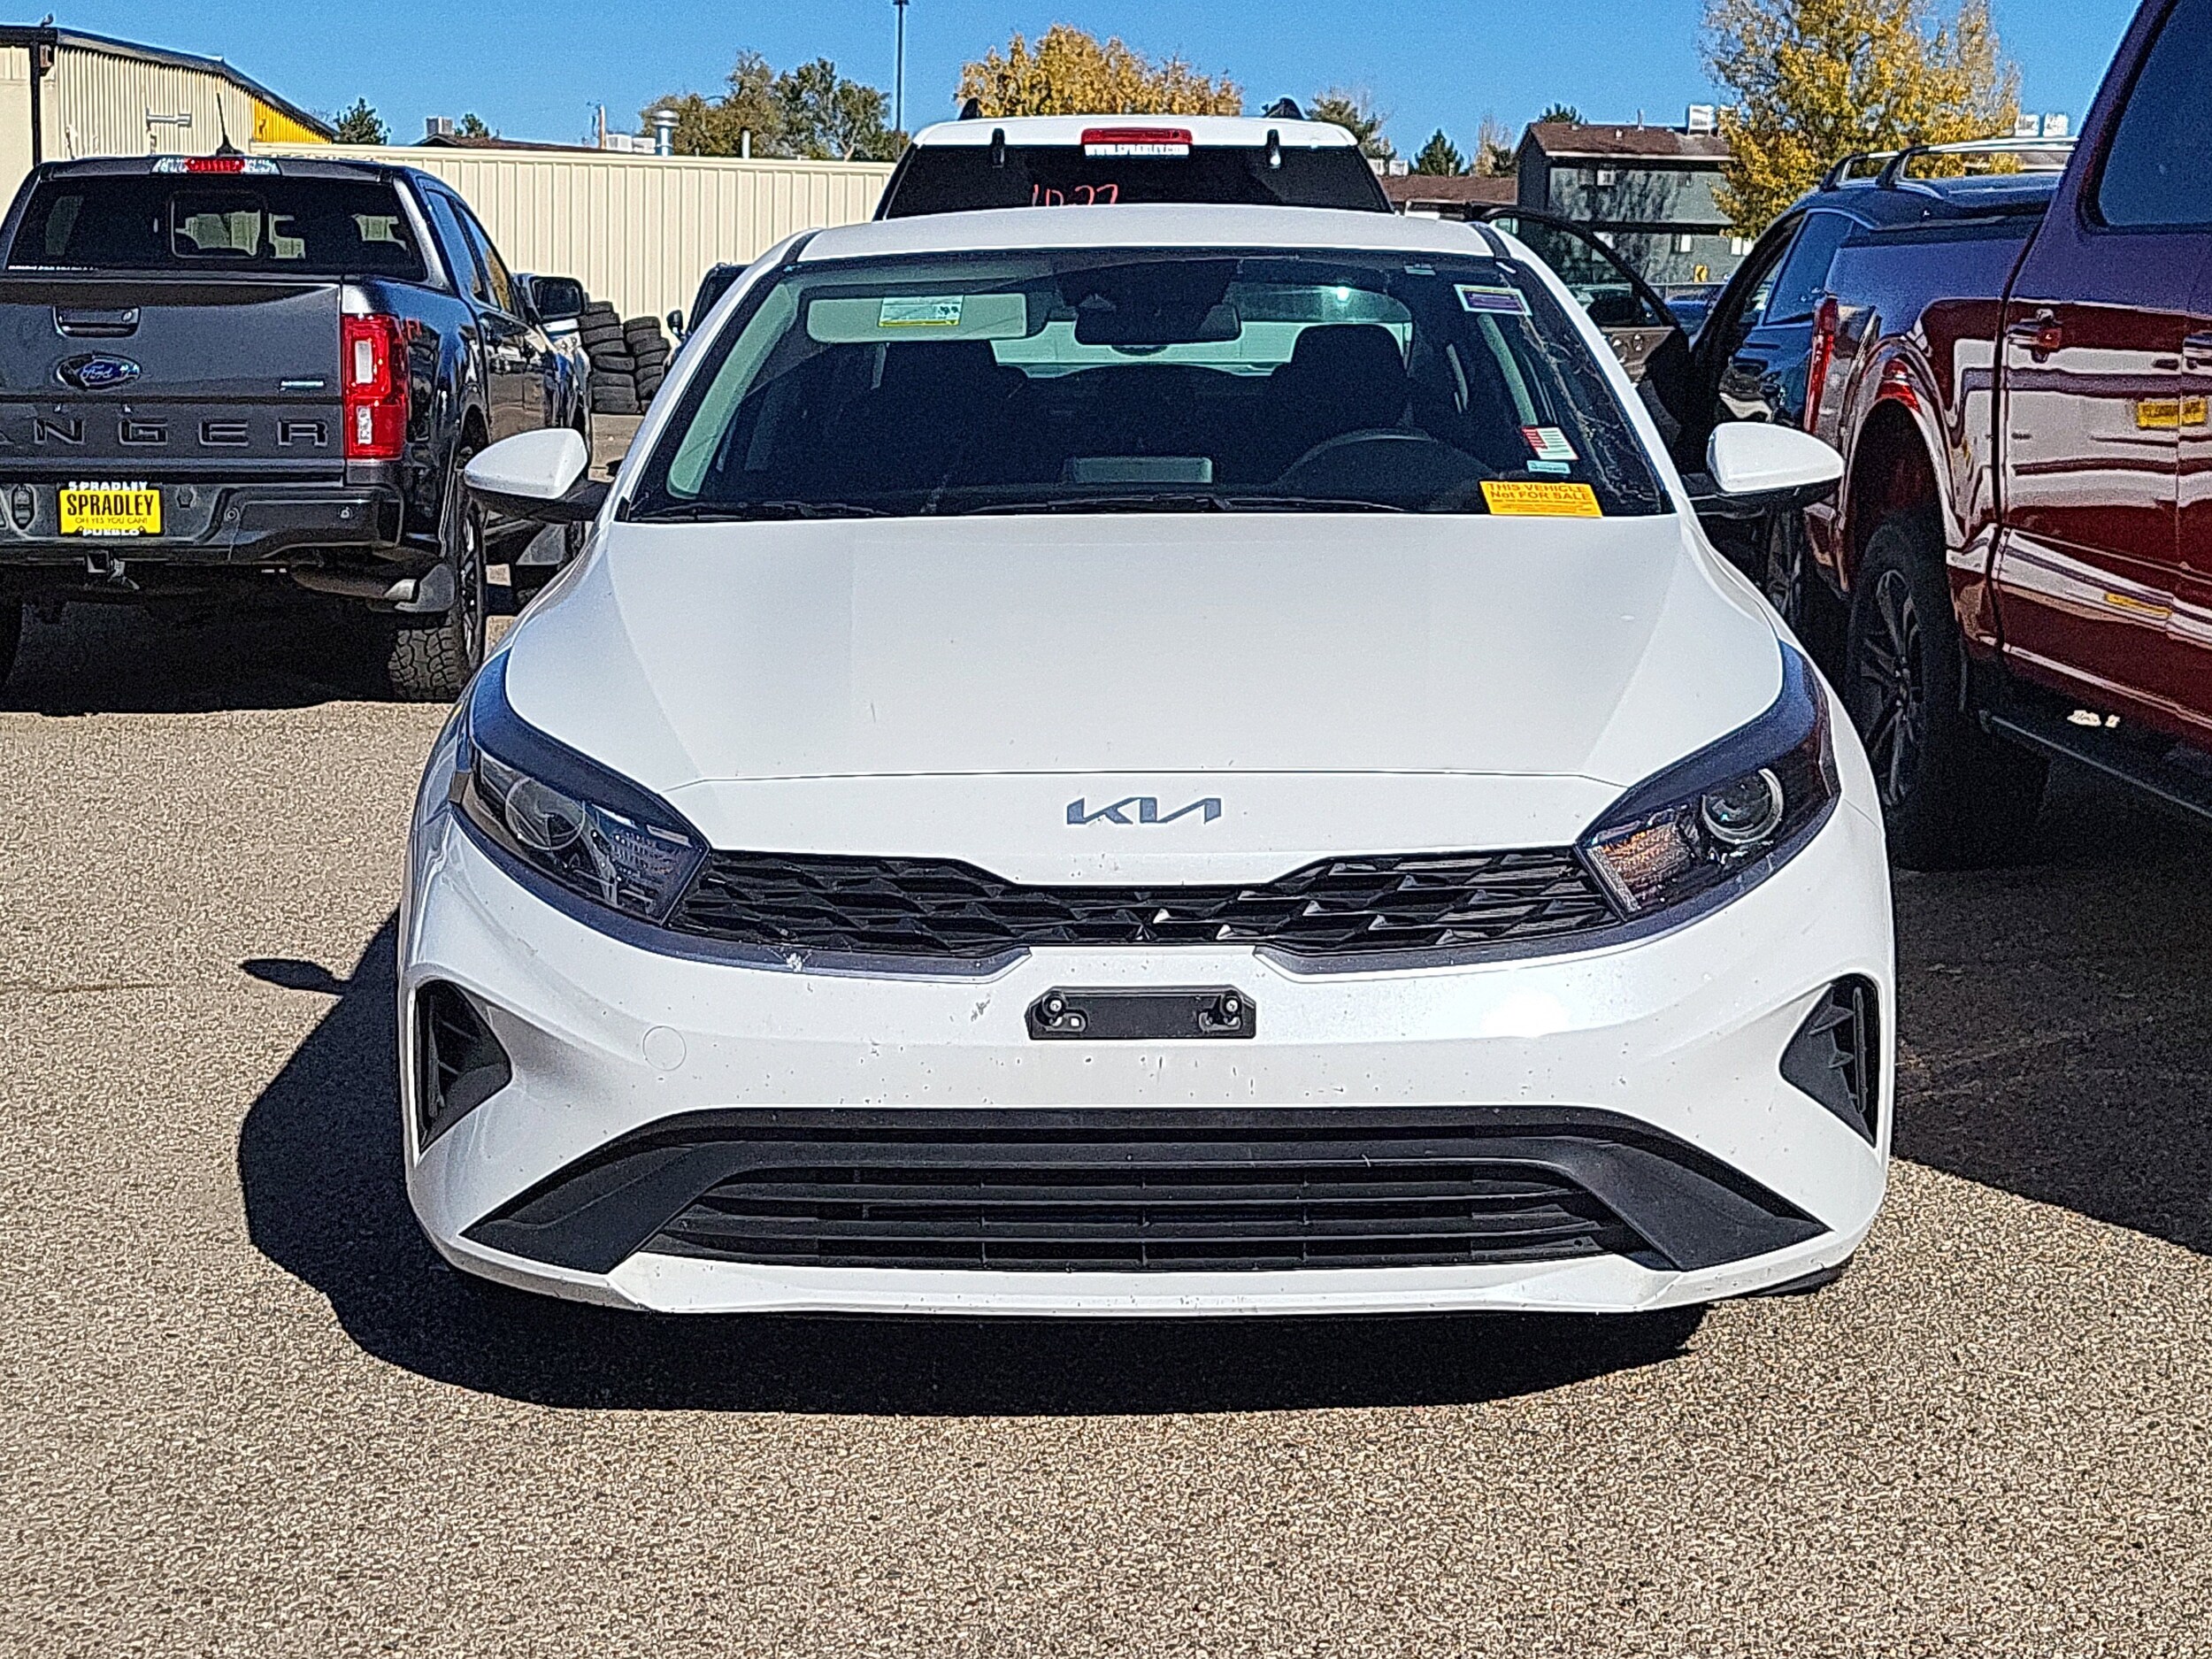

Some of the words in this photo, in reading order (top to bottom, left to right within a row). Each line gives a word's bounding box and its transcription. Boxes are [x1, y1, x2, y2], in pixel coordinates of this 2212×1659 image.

[80, 364, 113, 380] Ford
[0, 418, 329, 447] NGER
[1524, 484, 1587, 493] VEHICLE
[1553, 492, 1593, 501] SALE
[66, 493, 154, 516] SPRADLEY
[1066, 796, 1222, 825] KIA
